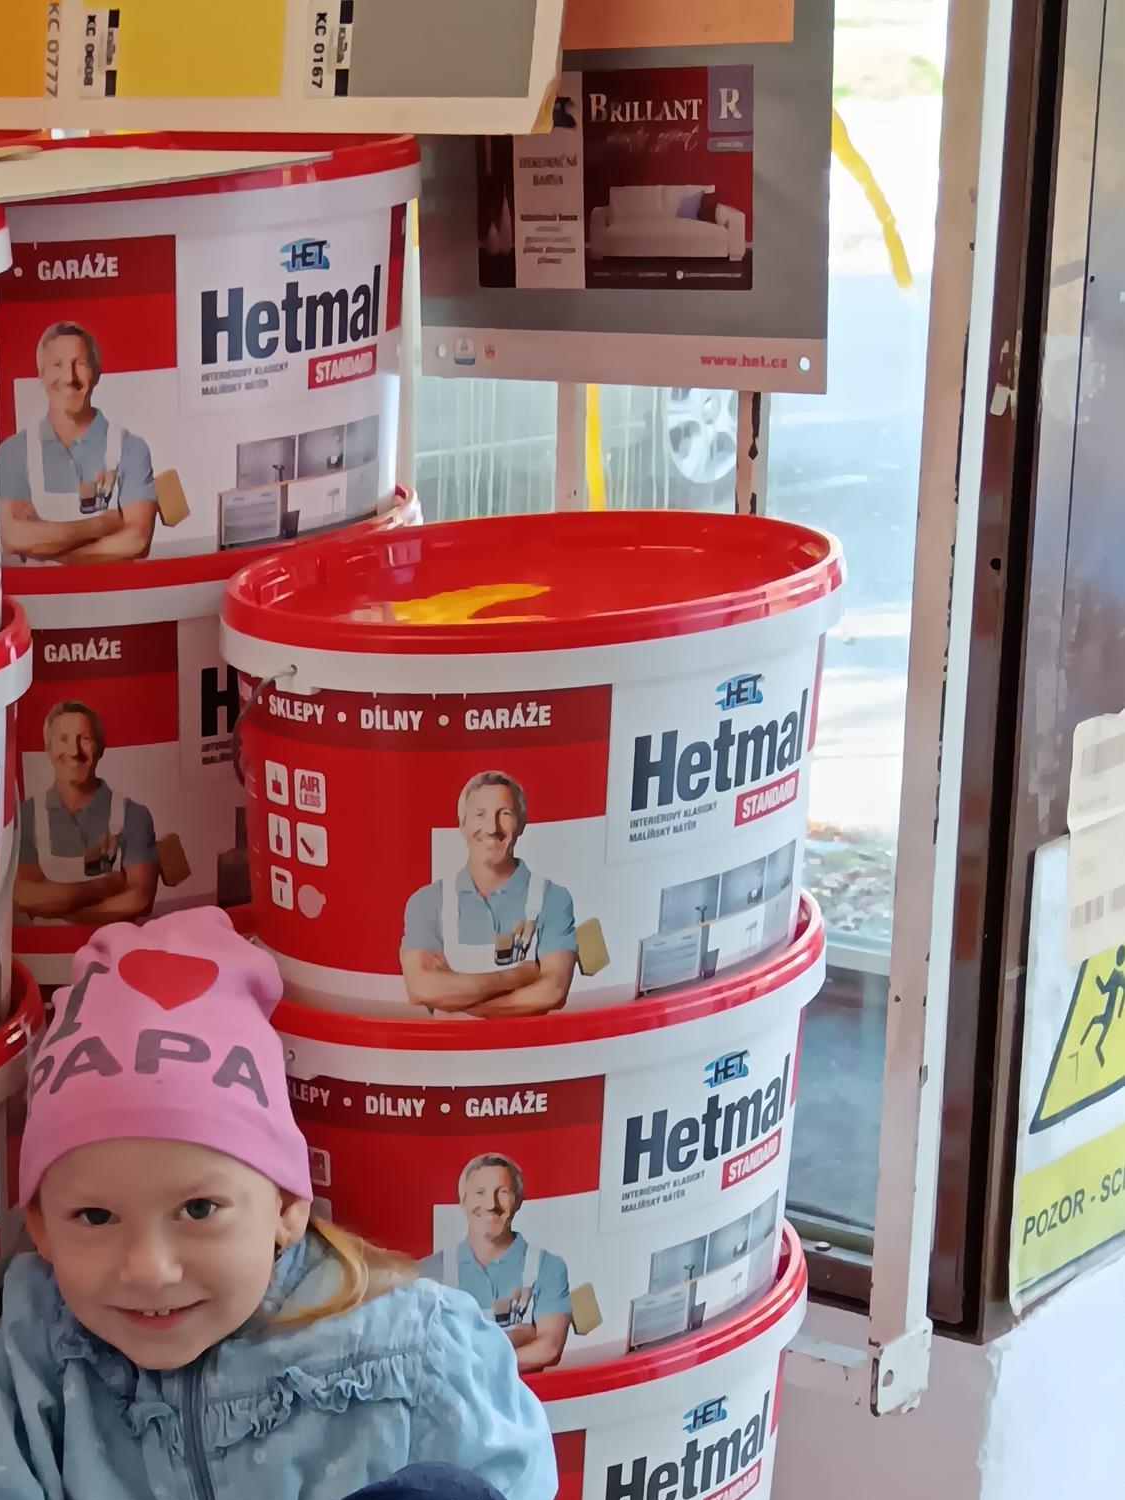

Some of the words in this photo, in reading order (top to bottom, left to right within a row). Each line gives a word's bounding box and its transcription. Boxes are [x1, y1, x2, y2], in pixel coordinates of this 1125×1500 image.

[48, 3, 60, 32] KC
[86, 15, 96, 36] KC
[315, 12, 327, 36] KC
[47, 40, 60, 97] 0777
[312, 43, 324, 88] 0167
[589, 93, 702, 122] BRILLANT
[719, 88, 743, 119] R
[37, 253, 118, 281] GARÁŽE
[291, 240, 327, 267] HET
[201, 264, 382, 365] Hetmal
[315, 351, 373, 383] STANDARD
[700, 355, 787, 368] www.het.cz
[44, 637, 121, 662] GARÁŽE
[726, 674, 762, 707] HET
[269, 695, 324, 724] SKLEPY
[360, 704, 423, 731] DÍLNY
[465, 701, 551, 730] GARÁŽE
[631, 688, 808, 811] Hetmal
[299, 774, 320, 792] AIR
[742, 777, 795, 818] STANDARD
[714, 1050, 748, 1083] HET
[366, 1093, 425, 1118] DÍLNY
[465, 1091, 547, 1118] GARÁŽE
[623, 1052, 790, 1185] Hetmal
[728, 1136, 779, 1182] STANDARD
[1023, 1189, 1085, 1245] POZOR
[1100, 1166, 1125, 1203] SC
[693, 1396, 727, 1429] HET
